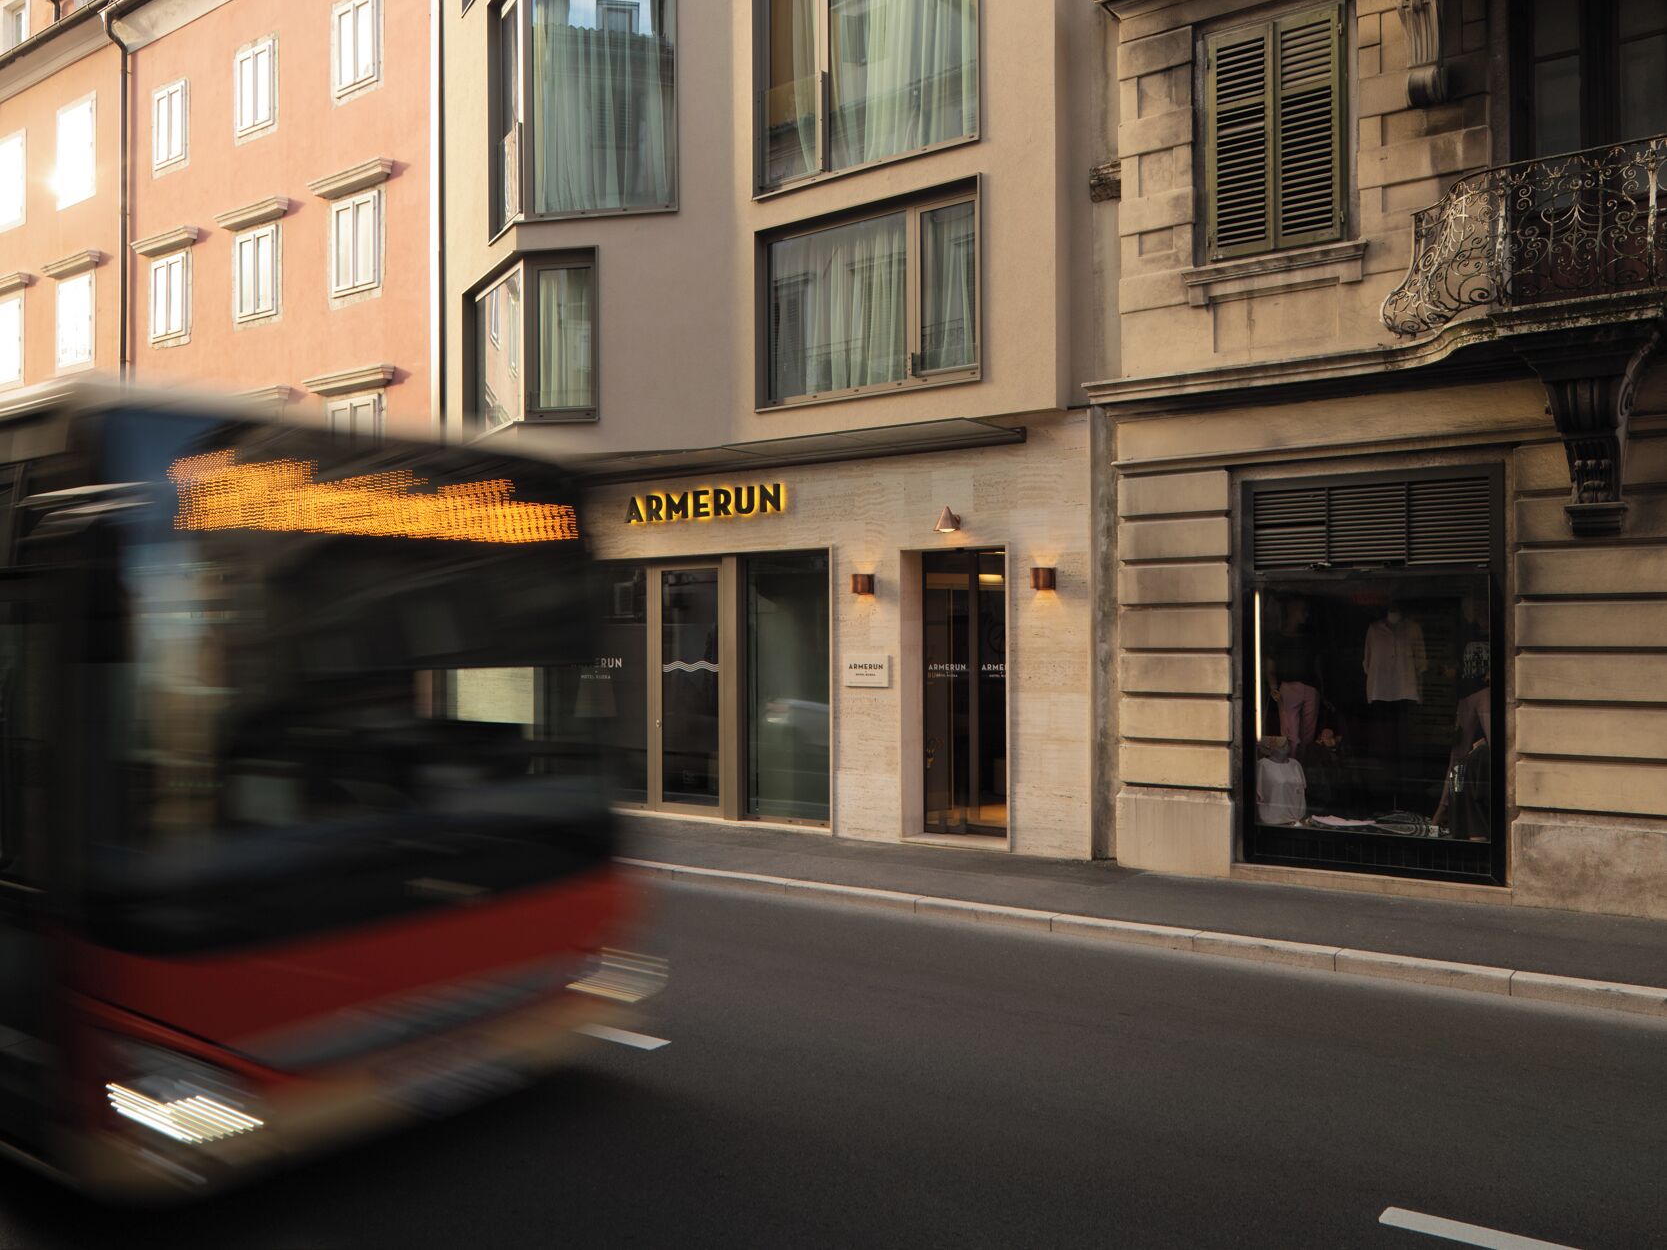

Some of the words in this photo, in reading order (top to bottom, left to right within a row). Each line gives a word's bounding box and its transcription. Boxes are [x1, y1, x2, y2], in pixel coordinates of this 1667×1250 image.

[624, 483, 782, 524] ARMERUN
[928, 663, 967, 671] ARMERUN
[981, 663, 1006, 671] ARME
